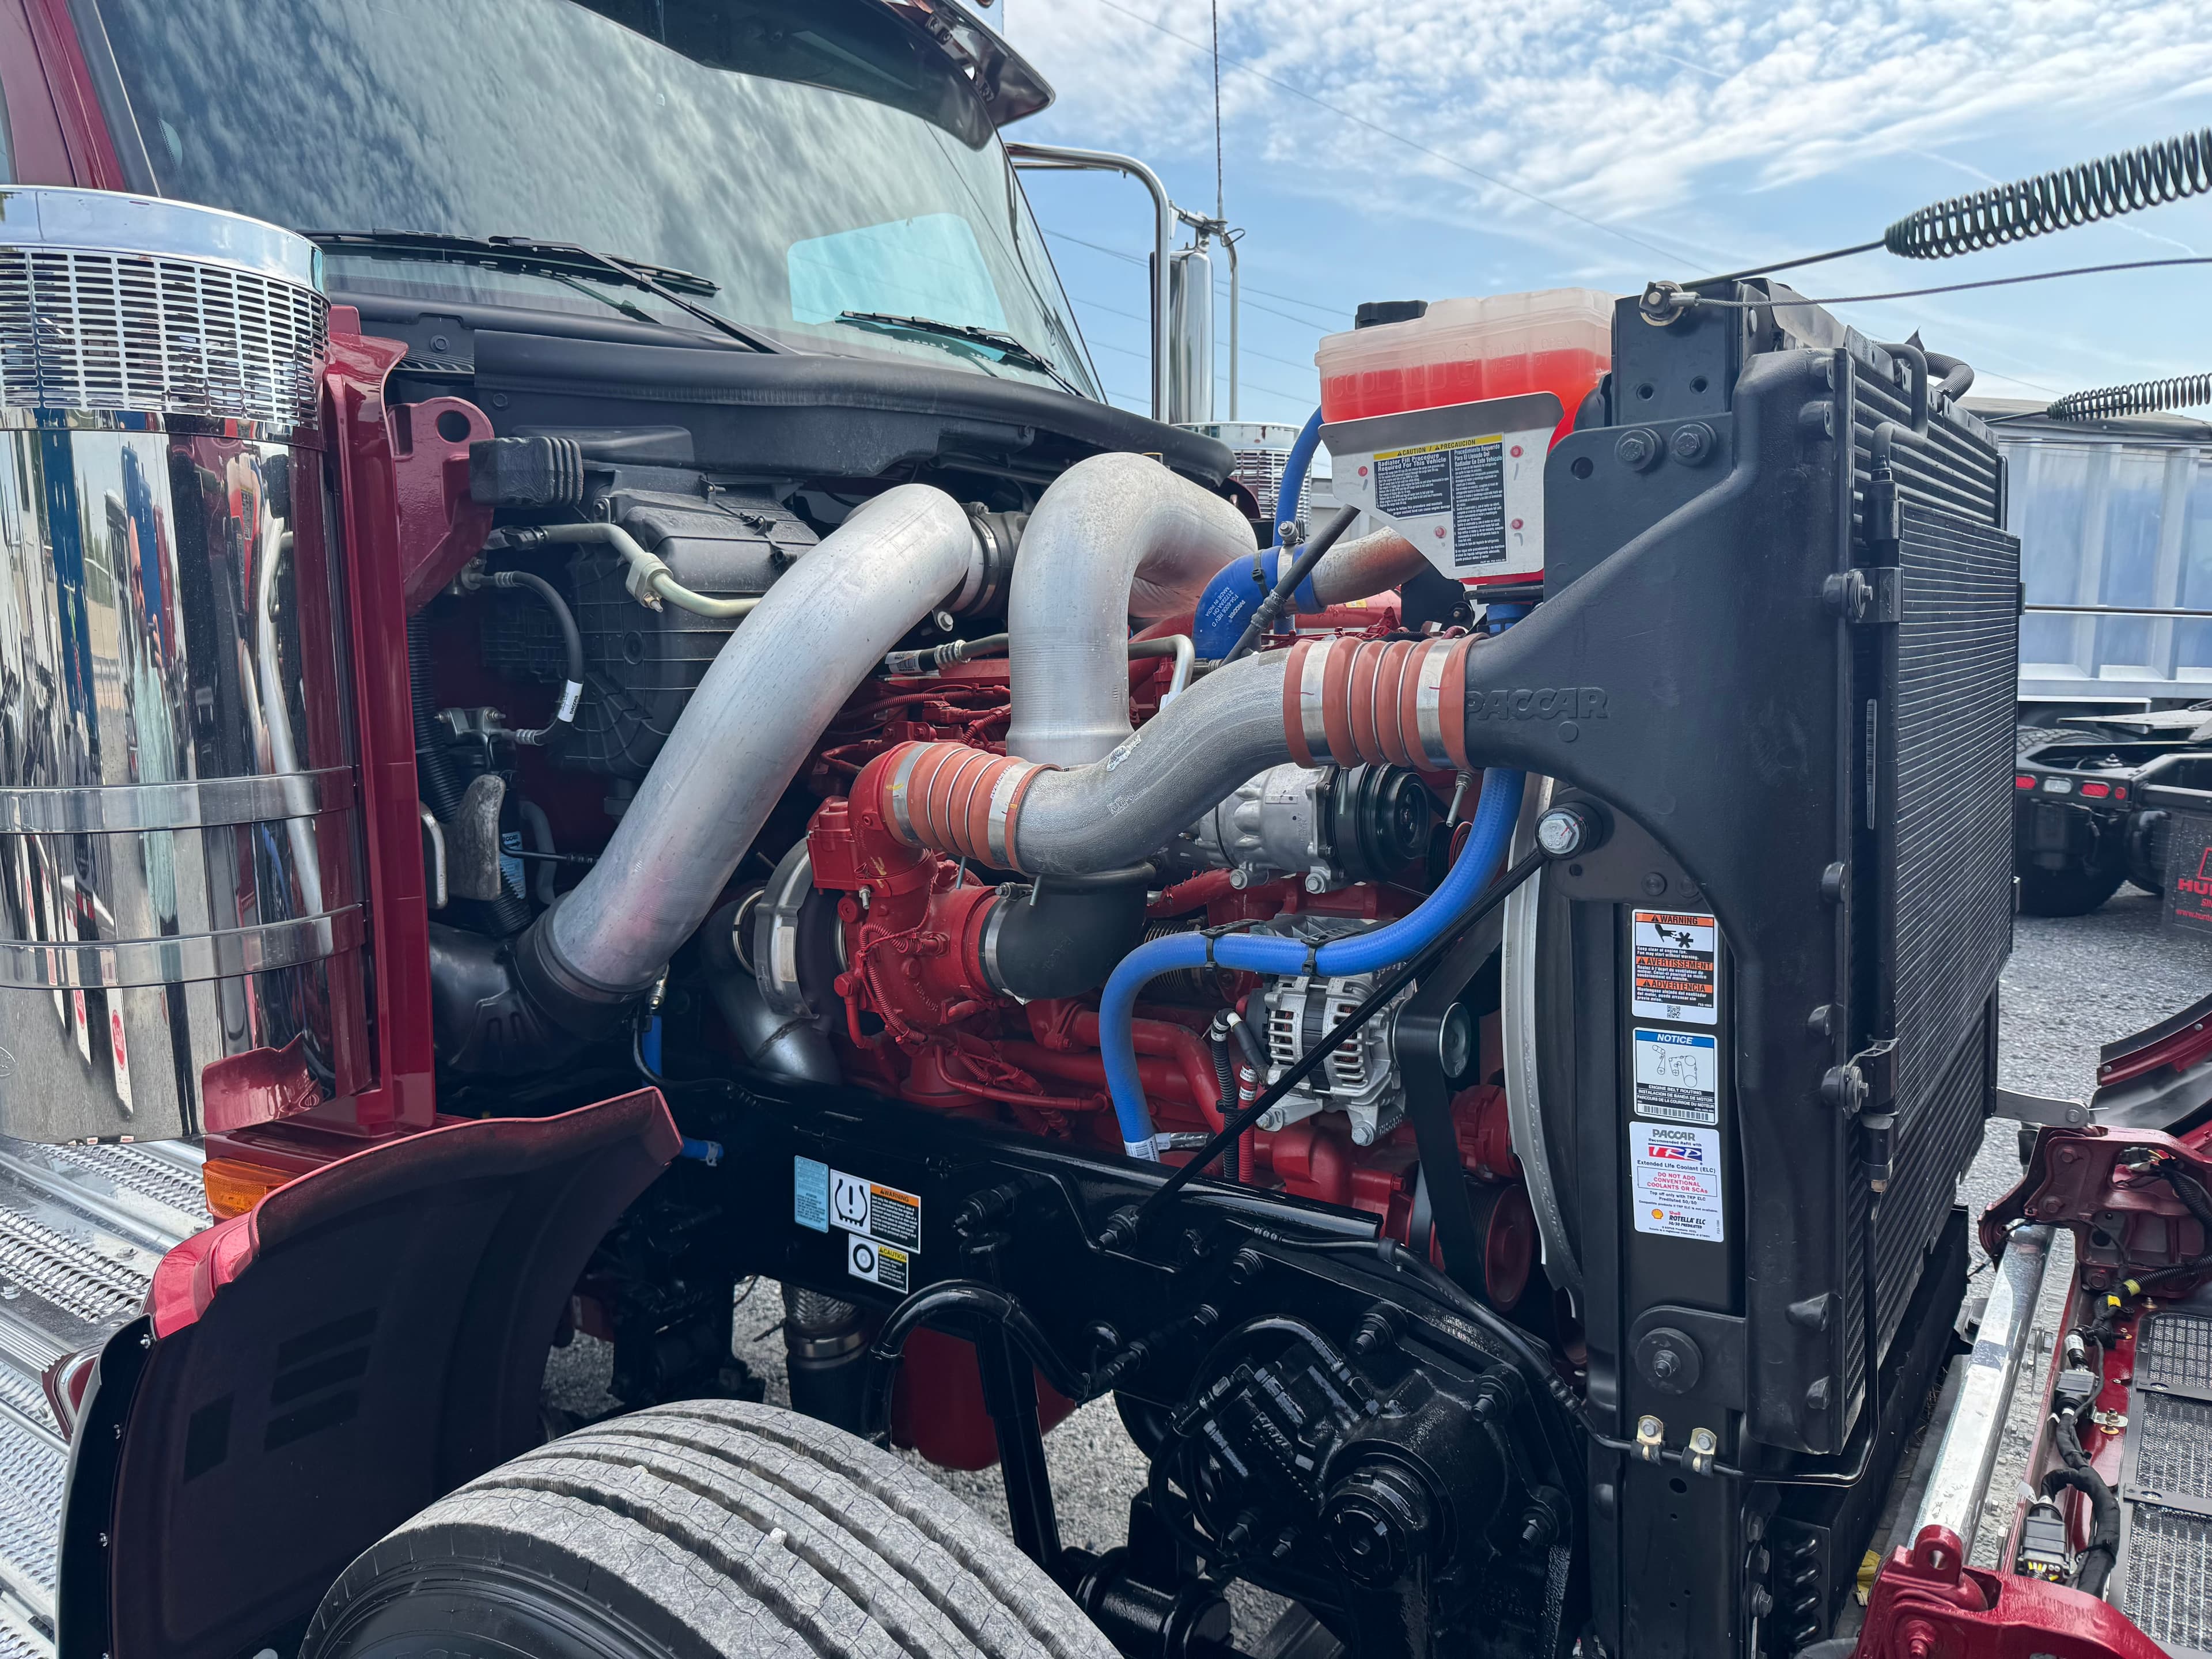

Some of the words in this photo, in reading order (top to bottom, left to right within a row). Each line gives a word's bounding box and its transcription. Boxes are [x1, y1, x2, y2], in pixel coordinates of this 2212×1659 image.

[1490, 358, 1520, 374] WHEN
[1331, 355, 1440, 397] COOLANT
[1402, 447, 1425, 455] CAUTION
[1440, 439, 1475, 449] PRECAUCION
[1377, 459, 1400, 467] Radiator
[1411, 453, 1438, 461] Procedure
[1378, 463, 1402, 472] Required
[1426, 456, 1446, 464] Vehicle
[1217, 586, 1230, 600] MADE
[1205, 604, 1215, 617] INDIA
[1228, 600, 1246, 619] PACCAR
[1214, 612, 1224, 623] REV
[569, 695, 579, 714] PACCAR
[1465, 687, 1609, 721] PACCAR
[2178, 878, 2212, 896] HU
[1660, 915, 1697, 924] WARNING
[1647, 958, 1710, 969] AVERTISSEMENT
[1652, 980, 1705, 991] ADVERTENCIA
[1657, 1034, 1692, 1044] NOTICE
[1652, 1128, 1695, 1141] PACCAR
[1647, 1181, 1679, 1190] COOLANTS
[1653, 1177, 1700, 1187] CONVENTIONAL
[884, 1190, 908, 1202] WARNING
[884, 1248, 906, 1263] CAUTION
